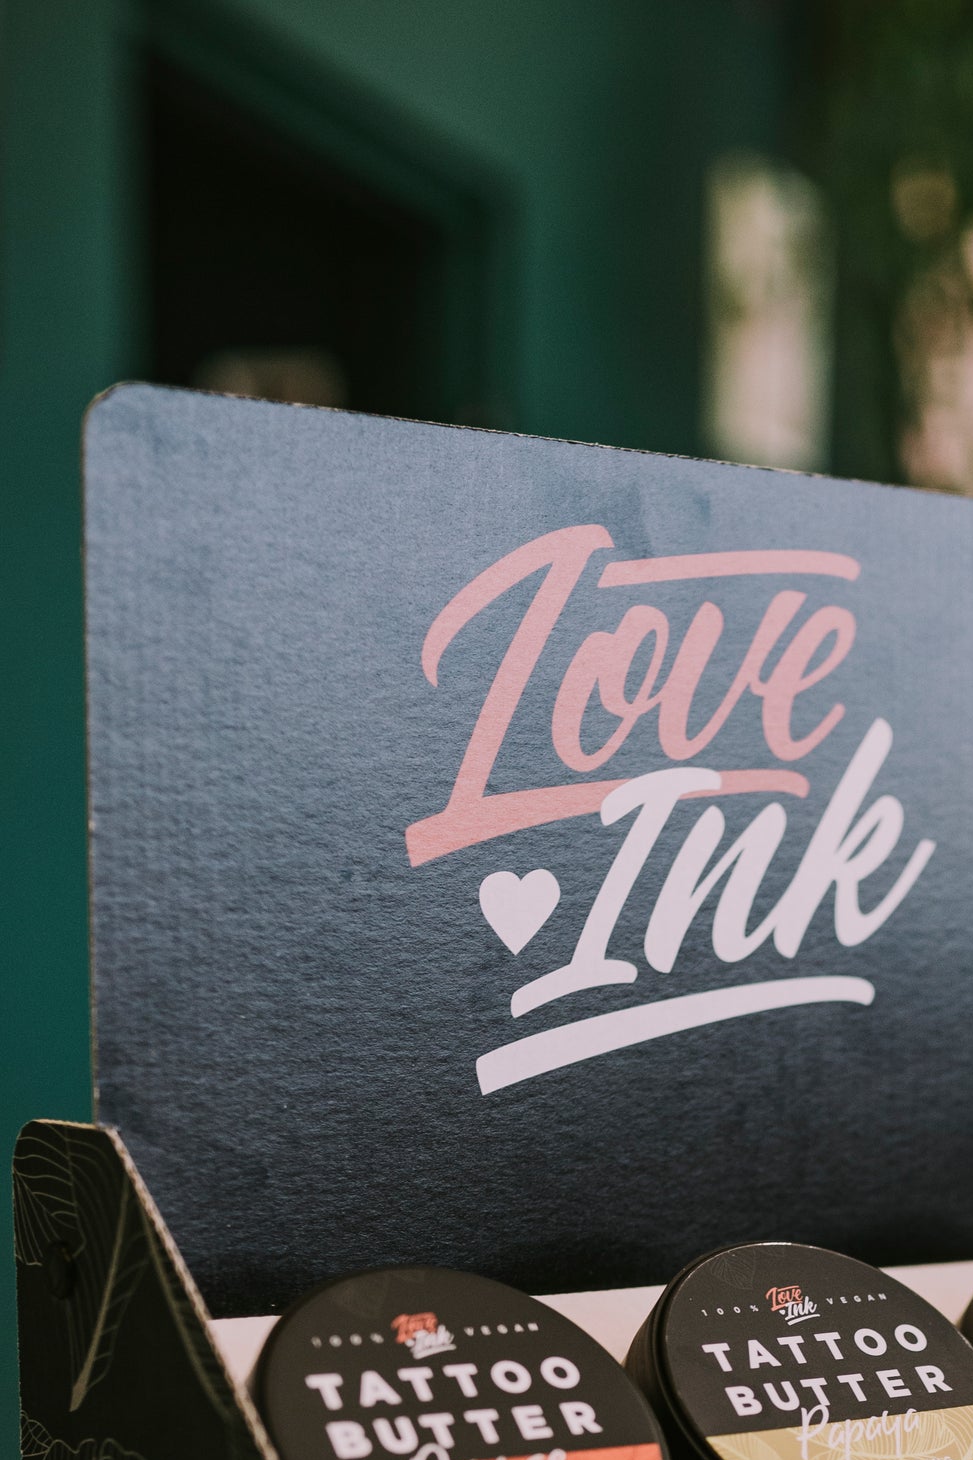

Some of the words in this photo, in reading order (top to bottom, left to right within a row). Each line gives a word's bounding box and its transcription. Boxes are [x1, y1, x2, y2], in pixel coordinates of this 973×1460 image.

[405, 524, 861, 867] Love
[509, 717, 937, 1018] Ink
[701, 1304, 759, 1317] 100%
[765, 1285, 804, 1312] Love
[785, 1296, 818, 1321] Ink
[826, 1292, 887, 1305] VEGAN
[701, 1323, 928, 1373] TATTOO
[304, 1355, 581, 1411] TATTOO
[724, 1364, 953, 1417] BUTTER
[324, 1399, 604, 1460] BUTTER
